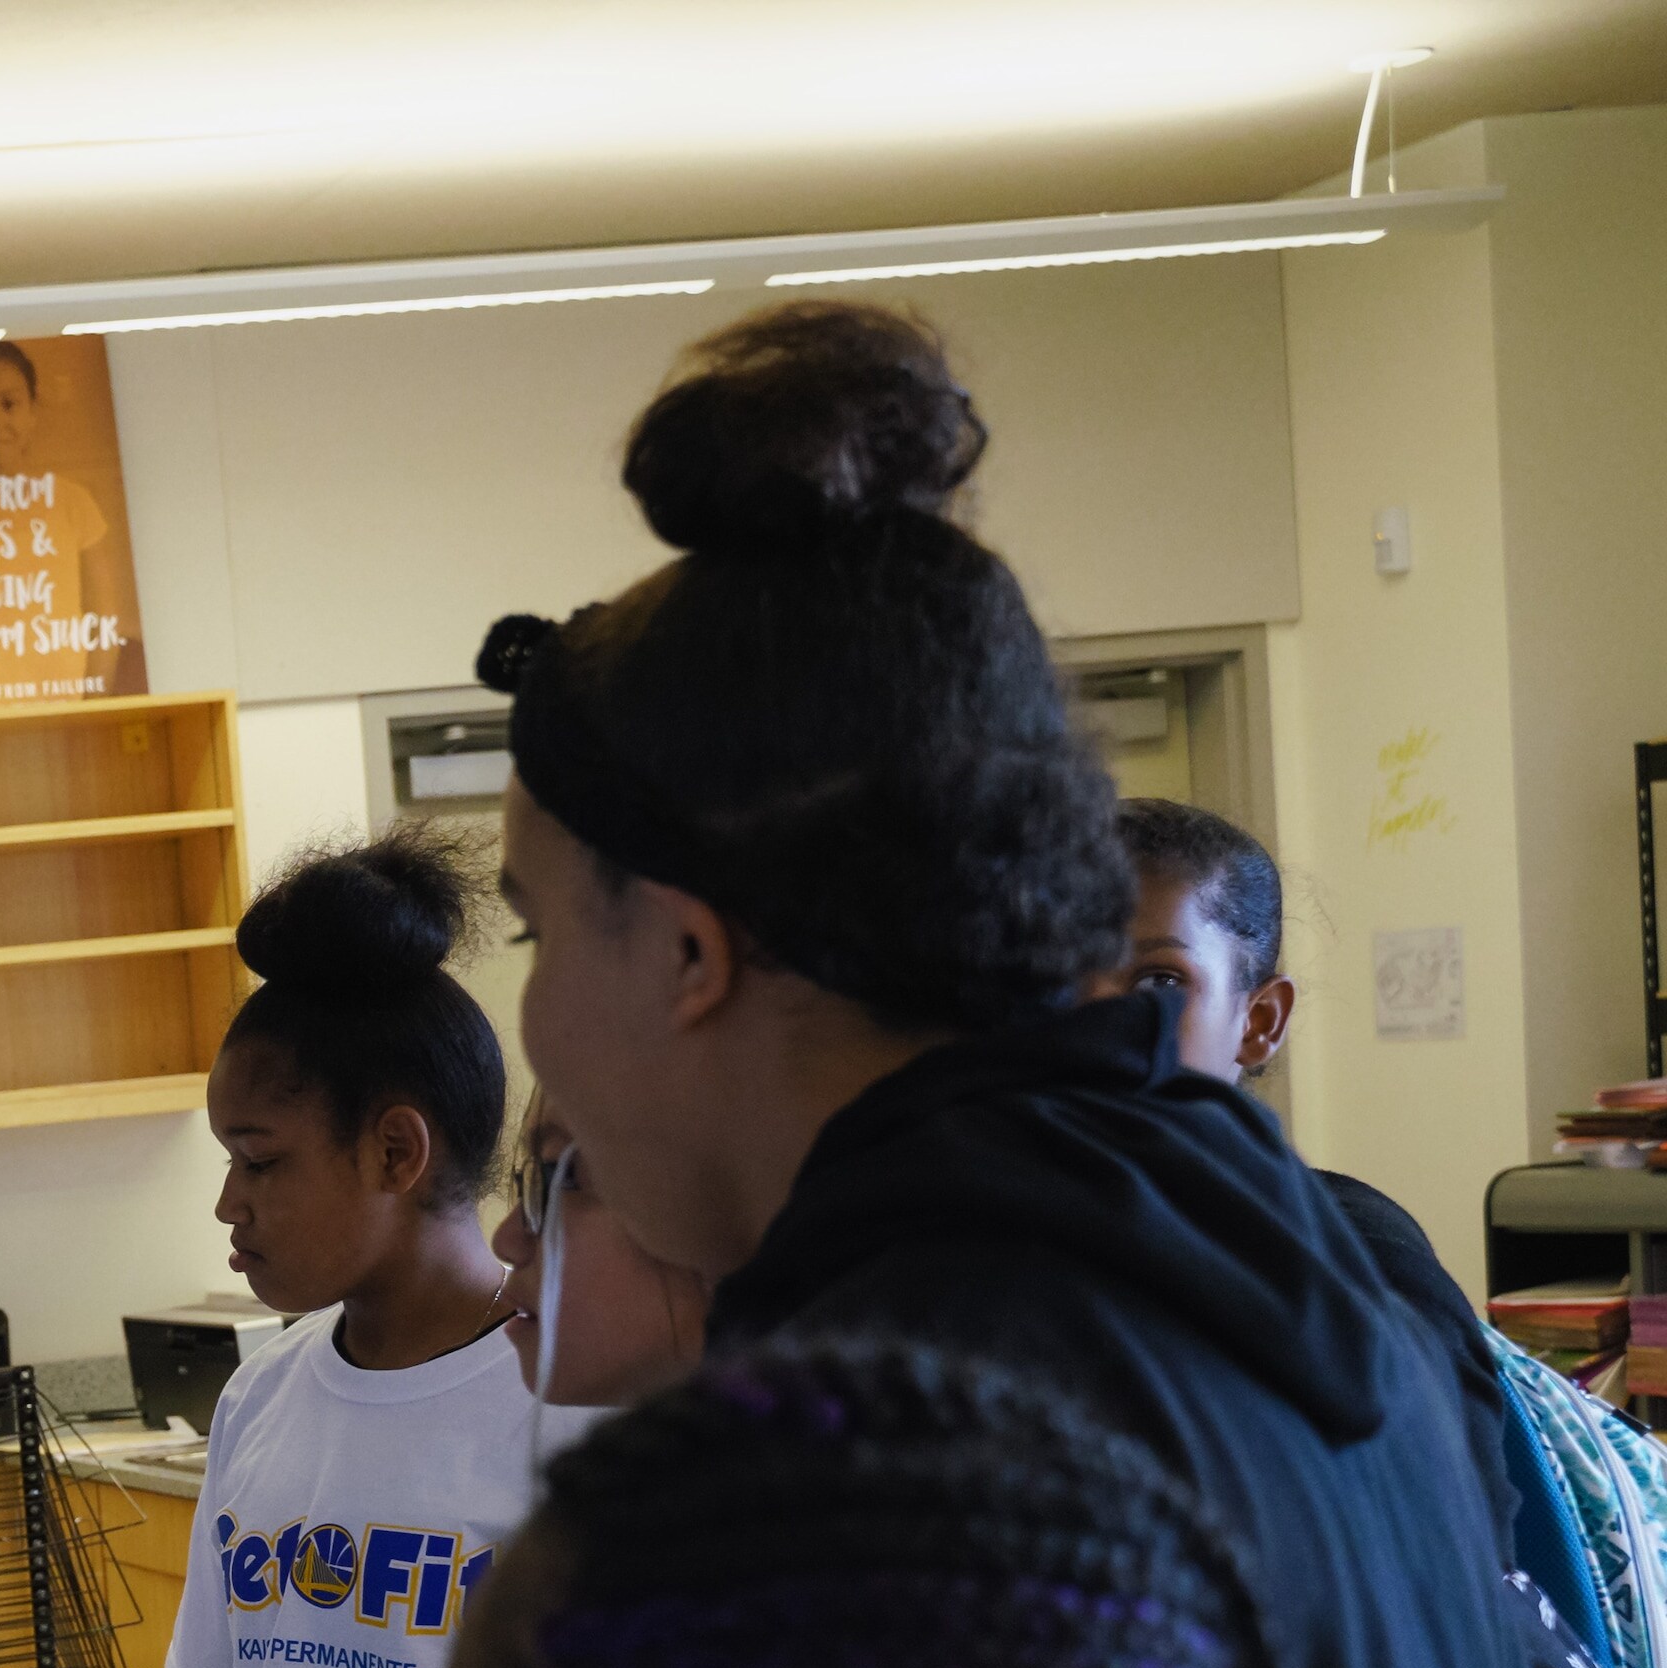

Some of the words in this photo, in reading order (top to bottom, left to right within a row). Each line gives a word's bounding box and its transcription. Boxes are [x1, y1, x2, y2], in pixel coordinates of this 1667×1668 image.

[30, 517, 57, 557] &
[30, 611, 128, 655] STUCK.
[42, 675, 106, 696] FAILURE
[238, 1638, 271, 1661] KAI
